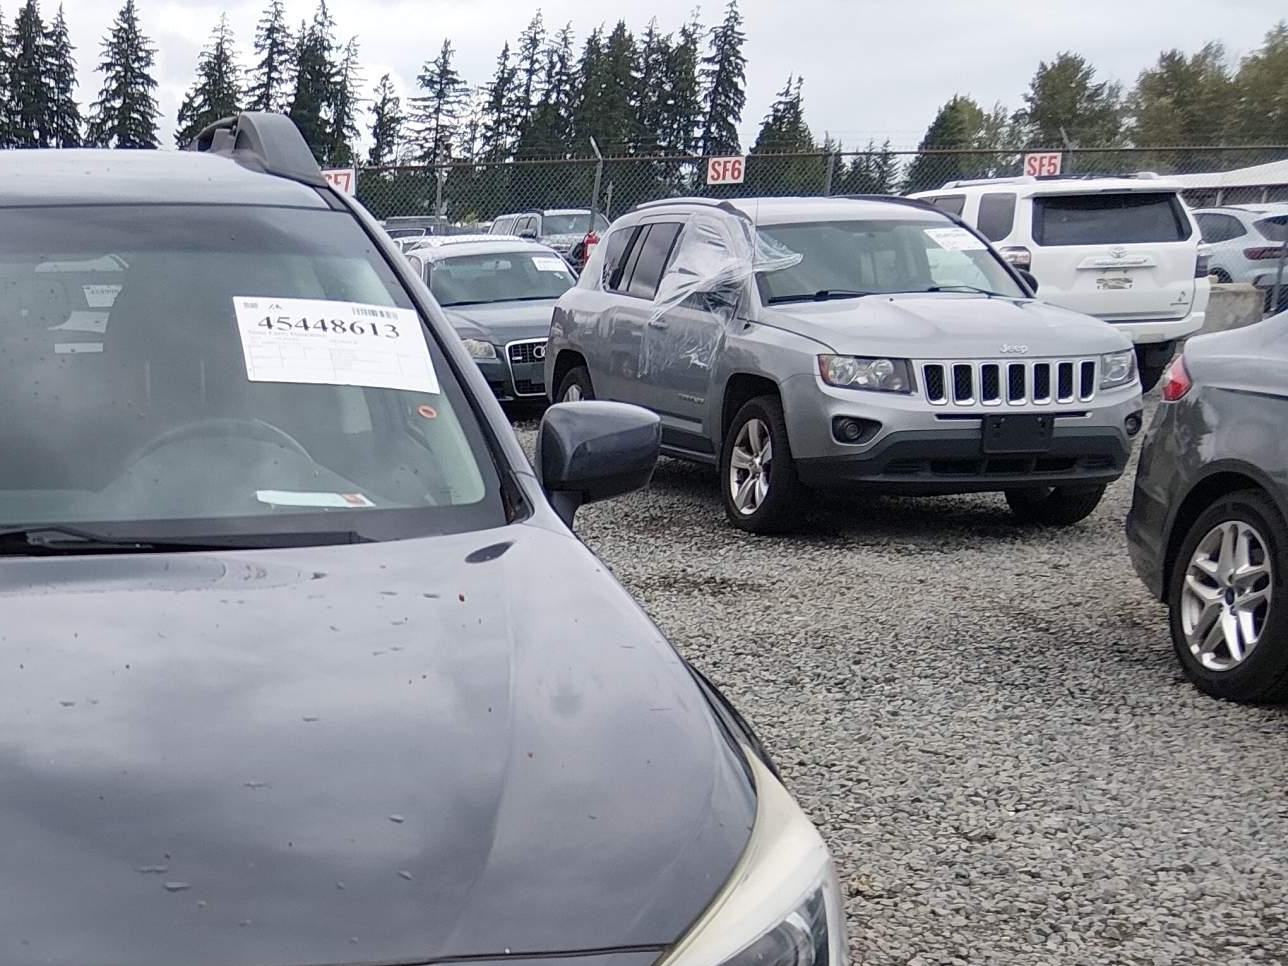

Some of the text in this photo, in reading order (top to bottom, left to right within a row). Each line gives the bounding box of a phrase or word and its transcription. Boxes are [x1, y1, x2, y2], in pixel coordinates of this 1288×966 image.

[710, 159, 742, 182] SF6
[1027, 155, 1058, 177] SF5
[325, 172, 351, 193] F7
[258, 316, 400, 339] 45448613
